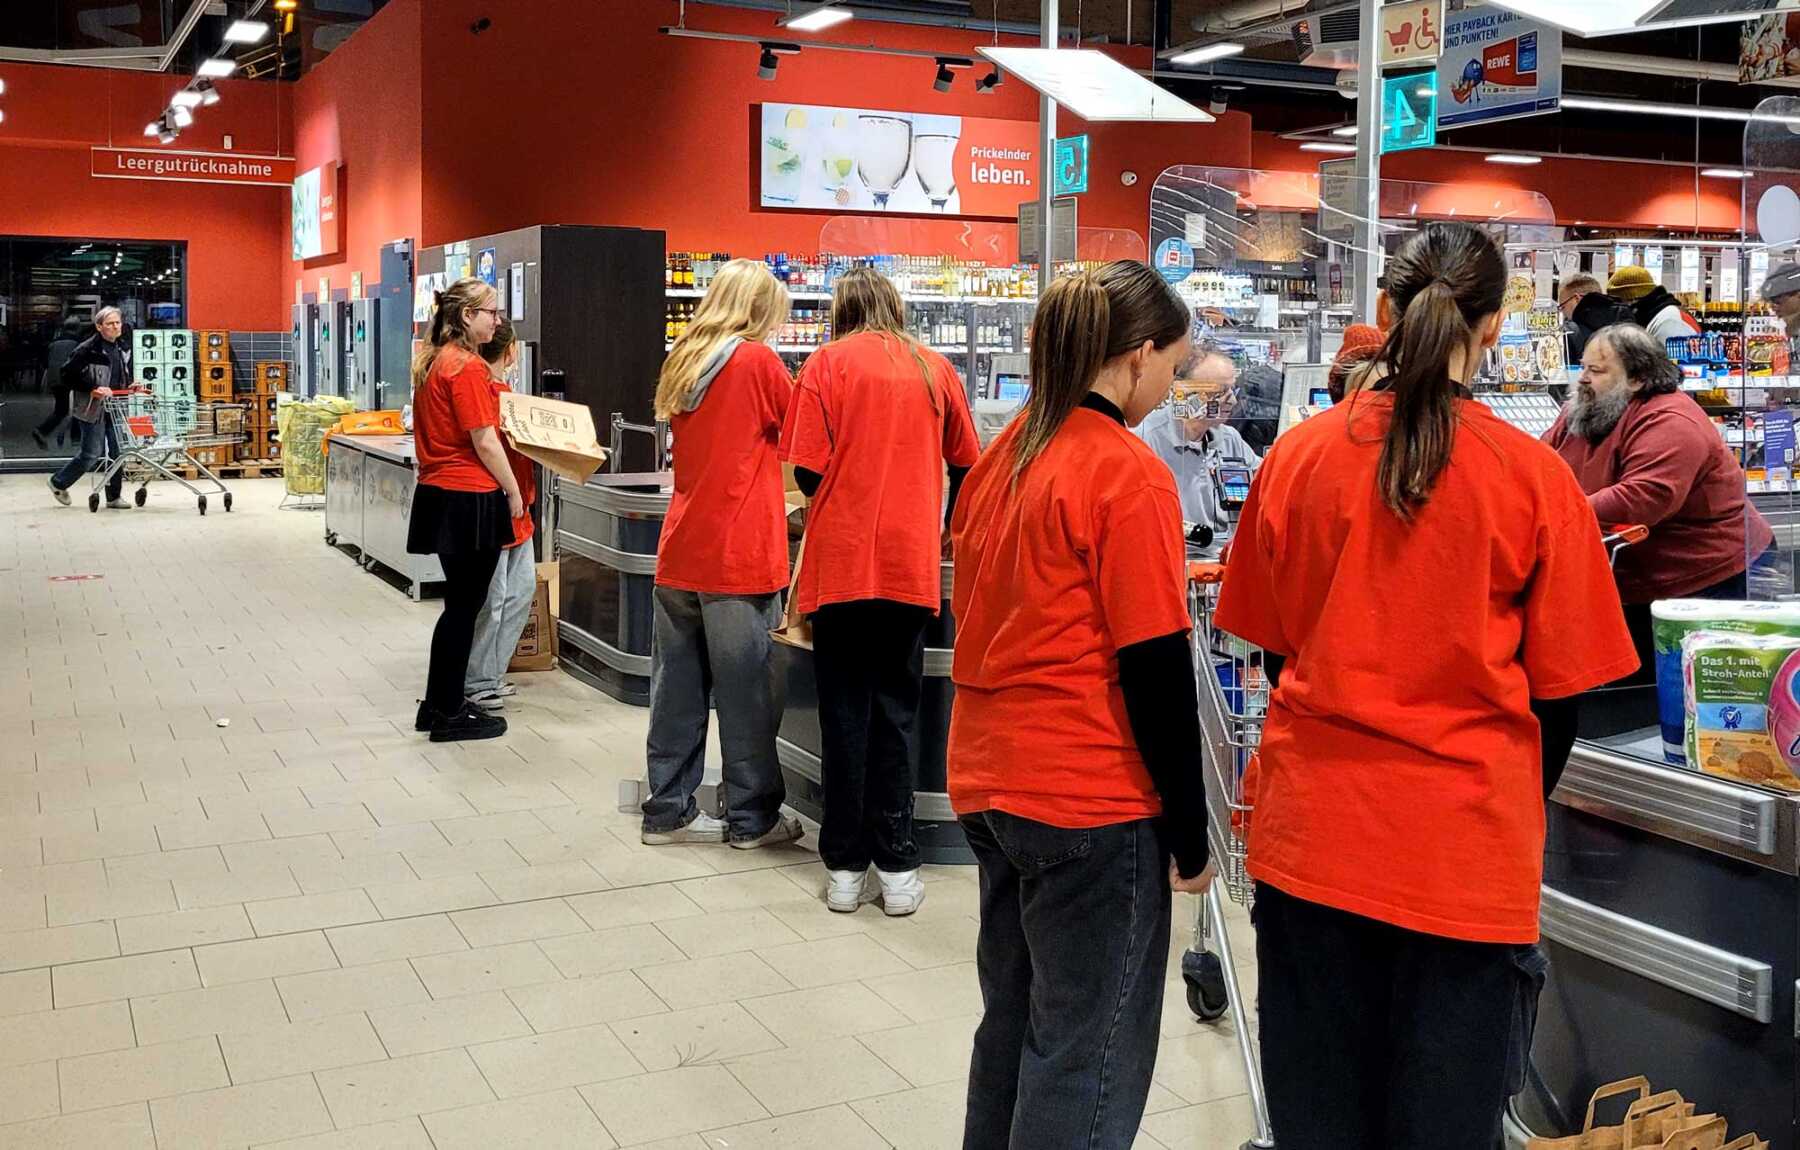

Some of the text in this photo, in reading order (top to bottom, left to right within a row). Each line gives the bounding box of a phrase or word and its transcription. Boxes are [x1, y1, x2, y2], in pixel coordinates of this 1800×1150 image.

[1462, 15, 1496, 32] PAYBACK
[1444, 28, 1499, 49] UND PUNKTEN!
[1486, 54, 1511, 70] REWE
[970, 146, 1032, 161] Prickelnder
[117, 154, 272, 177] Leergutrücknahme
[970, 161, 1031, 186] leben.
[1700, 655, 1761, 667] Das 1. mit
